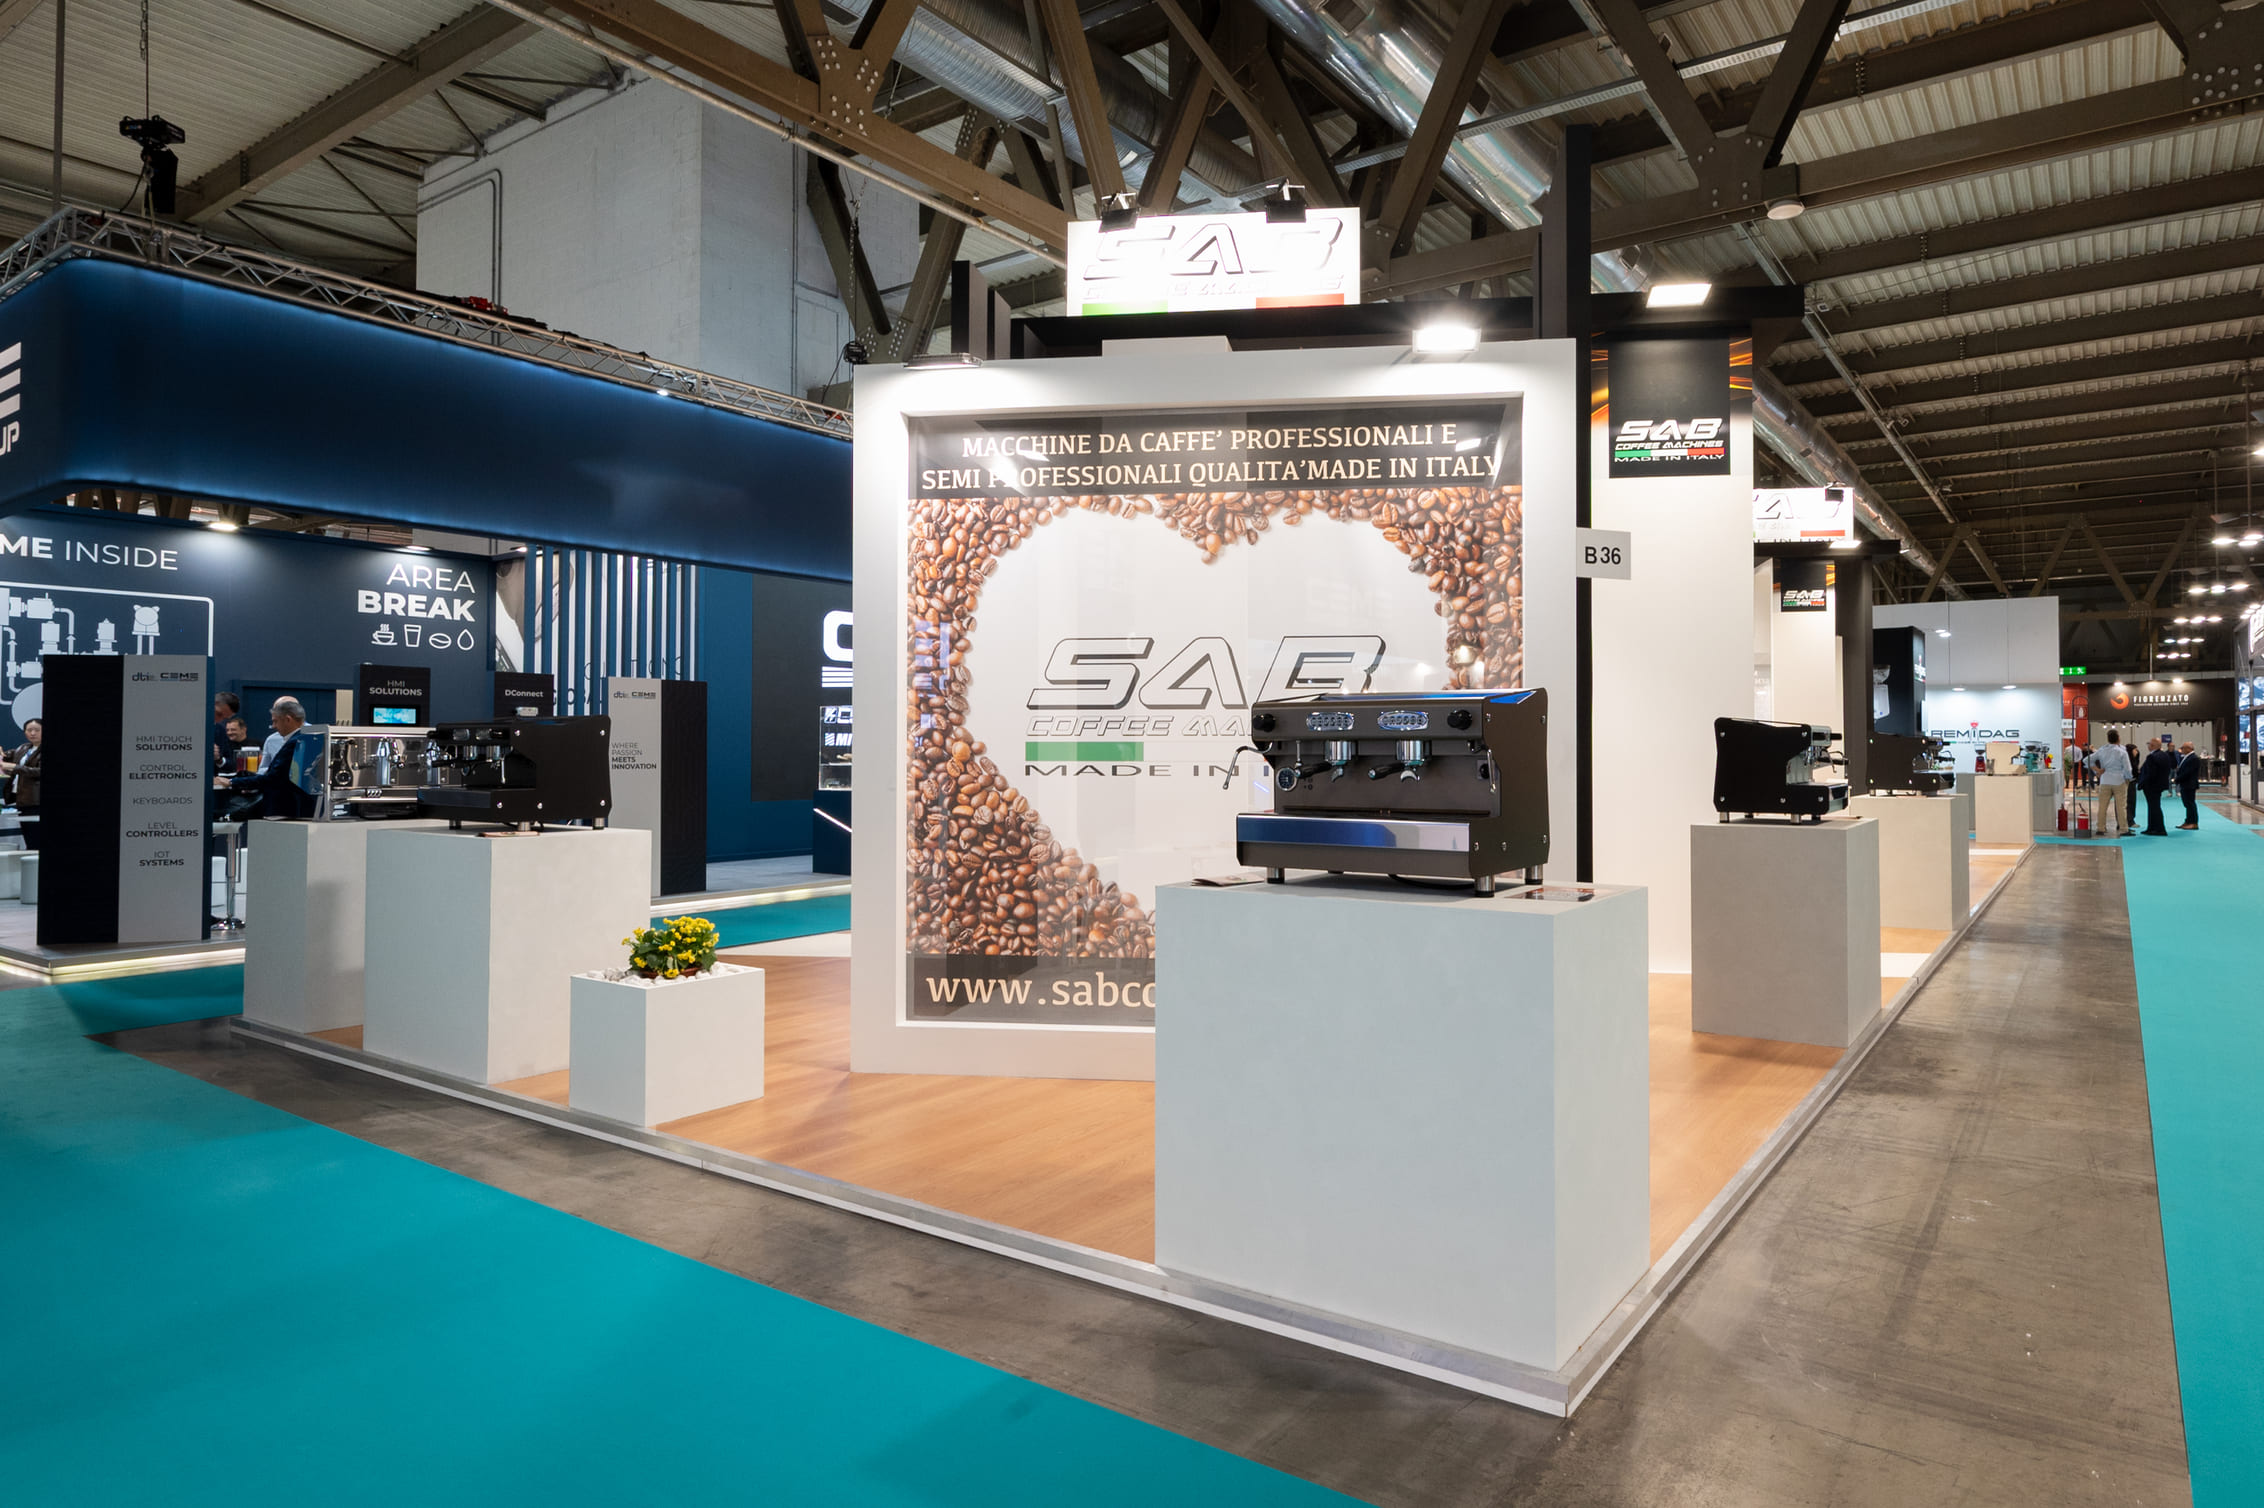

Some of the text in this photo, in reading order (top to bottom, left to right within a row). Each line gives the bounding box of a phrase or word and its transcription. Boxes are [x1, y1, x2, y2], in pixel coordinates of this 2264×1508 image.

[1615, 418, 1722, 442] SAB
[962, 434, 1091, 458] MACCHINE
[1099, 433, 1133, 454] DA
[1230, 424, 1433, 450] PROFESSIONALI
[1441, 423, 1457, 445] E
[1615, 440, 1724, 450] COFFEE MACHINES
[922, 469, 981, 490] SEMI
[988, 463, 1182, 488] POFESSIONALI
[1389, 457, 1417, 479] IN
[1425, 455, 1499, 478] ITALY
[65, 540, 178, 570] INSIDE
[386, 562, 476, 594] AREA
[1784, 589, 1825, 599] SAB
[358, 589, 476, 622] BREAK
[1026, 635, 1387, 711] SAB
[369, 687, 423, 696] SOLUTIONS
[504, 689, 544, 698] DConnect
[1025, 715, 1175, 737] COFFEE
[136, 735, 193, 743] HMI TOUCH
[135, 743, 193, 751] SOLUTIONS
[139, 764, 187, 772] CONTROL
[1025, 764, 1239, 777] MADE IN
[129, 772, 198, 780] ELECTRONICS
[132, 797, 193, 805] KEYBOARDS
[147, 822, 178, 830] LEVEL
[126, 830, 199, 838] CONTROLLERS
[153, 850, 170, 858] IOT
[139, 859, 185, 867] SYSTEMS
